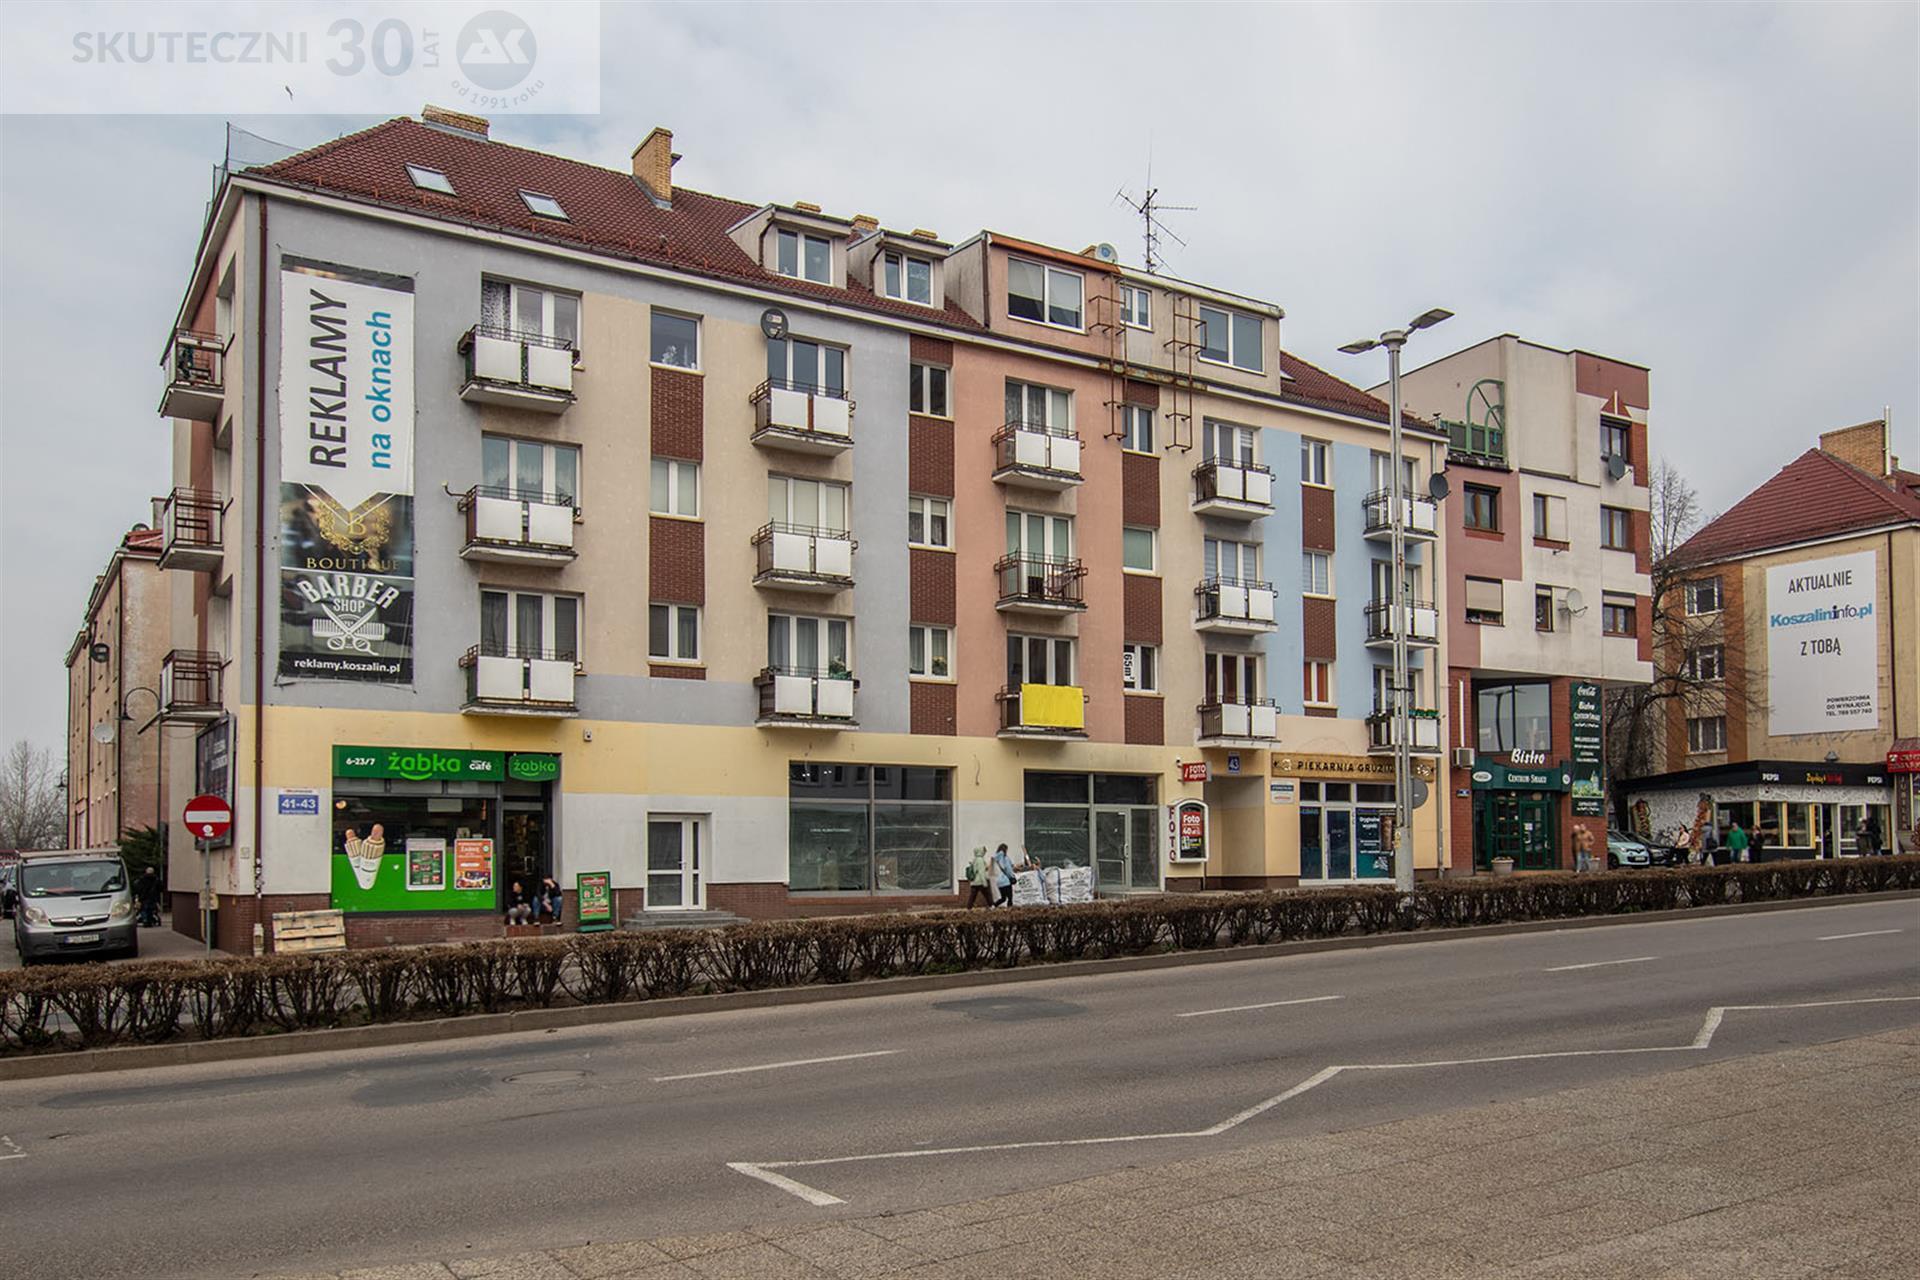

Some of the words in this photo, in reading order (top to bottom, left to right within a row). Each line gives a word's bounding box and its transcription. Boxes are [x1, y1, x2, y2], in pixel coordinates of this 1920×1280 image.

[365, 310, 392, 423] oknach
[309, 288, 347, 468] REKLAMY
[371, 433, 392, 469] na
[1788, 570, 1853, 594] AKTUALNIE
[296, 574, 400, 609] BARBER
[332, 598, 366, 613] SHOP
[1770, 603, 1873, 628] Koszalininfo.pl
[1800, 641, 1808, 656] Z
[1811, 637, 1842, 656] TOBĄ
[294, 658, 401, 674] reklamy.koszalin.pl
[387, 752, 462, 772] żabka
[1229, 758, 1239, 769] 43
[1511, 748, 1546, 764] Bistro
[513, 759, 556, 773] żabka
[1189, 764, 1207, 774] FOTO
[1297, 761, 1354, 773] PIEKARNIA
[281, 799, 316, 809] 41-43
[1183, 814, 1201, 823] Foto
[1168, 807, 1177, 861] FOTO
